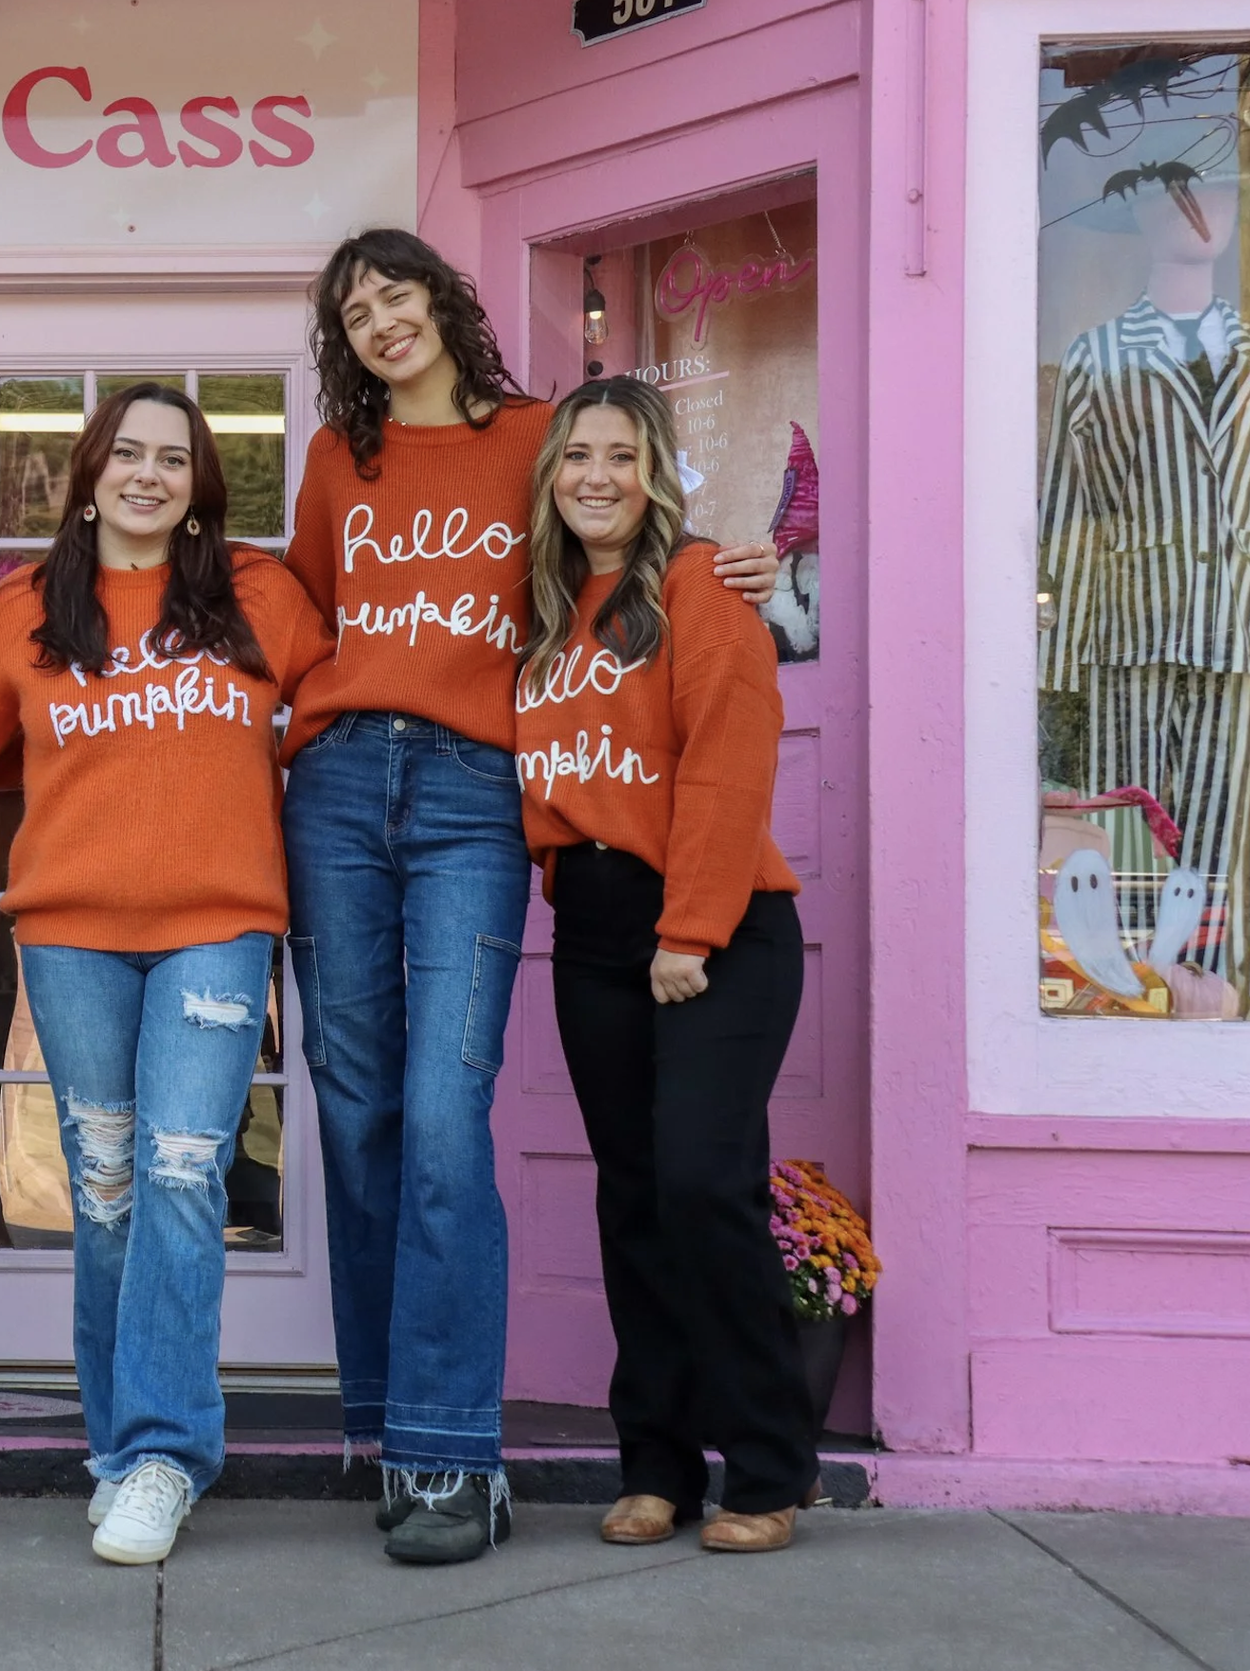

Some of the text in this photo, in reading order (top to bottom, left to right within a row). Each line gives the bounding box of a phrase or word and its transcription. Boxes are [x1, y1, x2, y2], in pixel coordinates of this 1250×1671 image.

[2, 66, 314, 168] Cass
[661, 253, 812, 343] Open
[675, 390, 723, 416] Closed
[688, 414, 716, 434] 10-6
[699, 431, 728, 453] 10-6
[344, 504, 527, 573] hello
[334, 581, 523, 666] pumpkin
[49, 666, 252, 748] pumpkin
[515, 644, 647, 714] ello
[515, 724, 660, 801] mpkin
